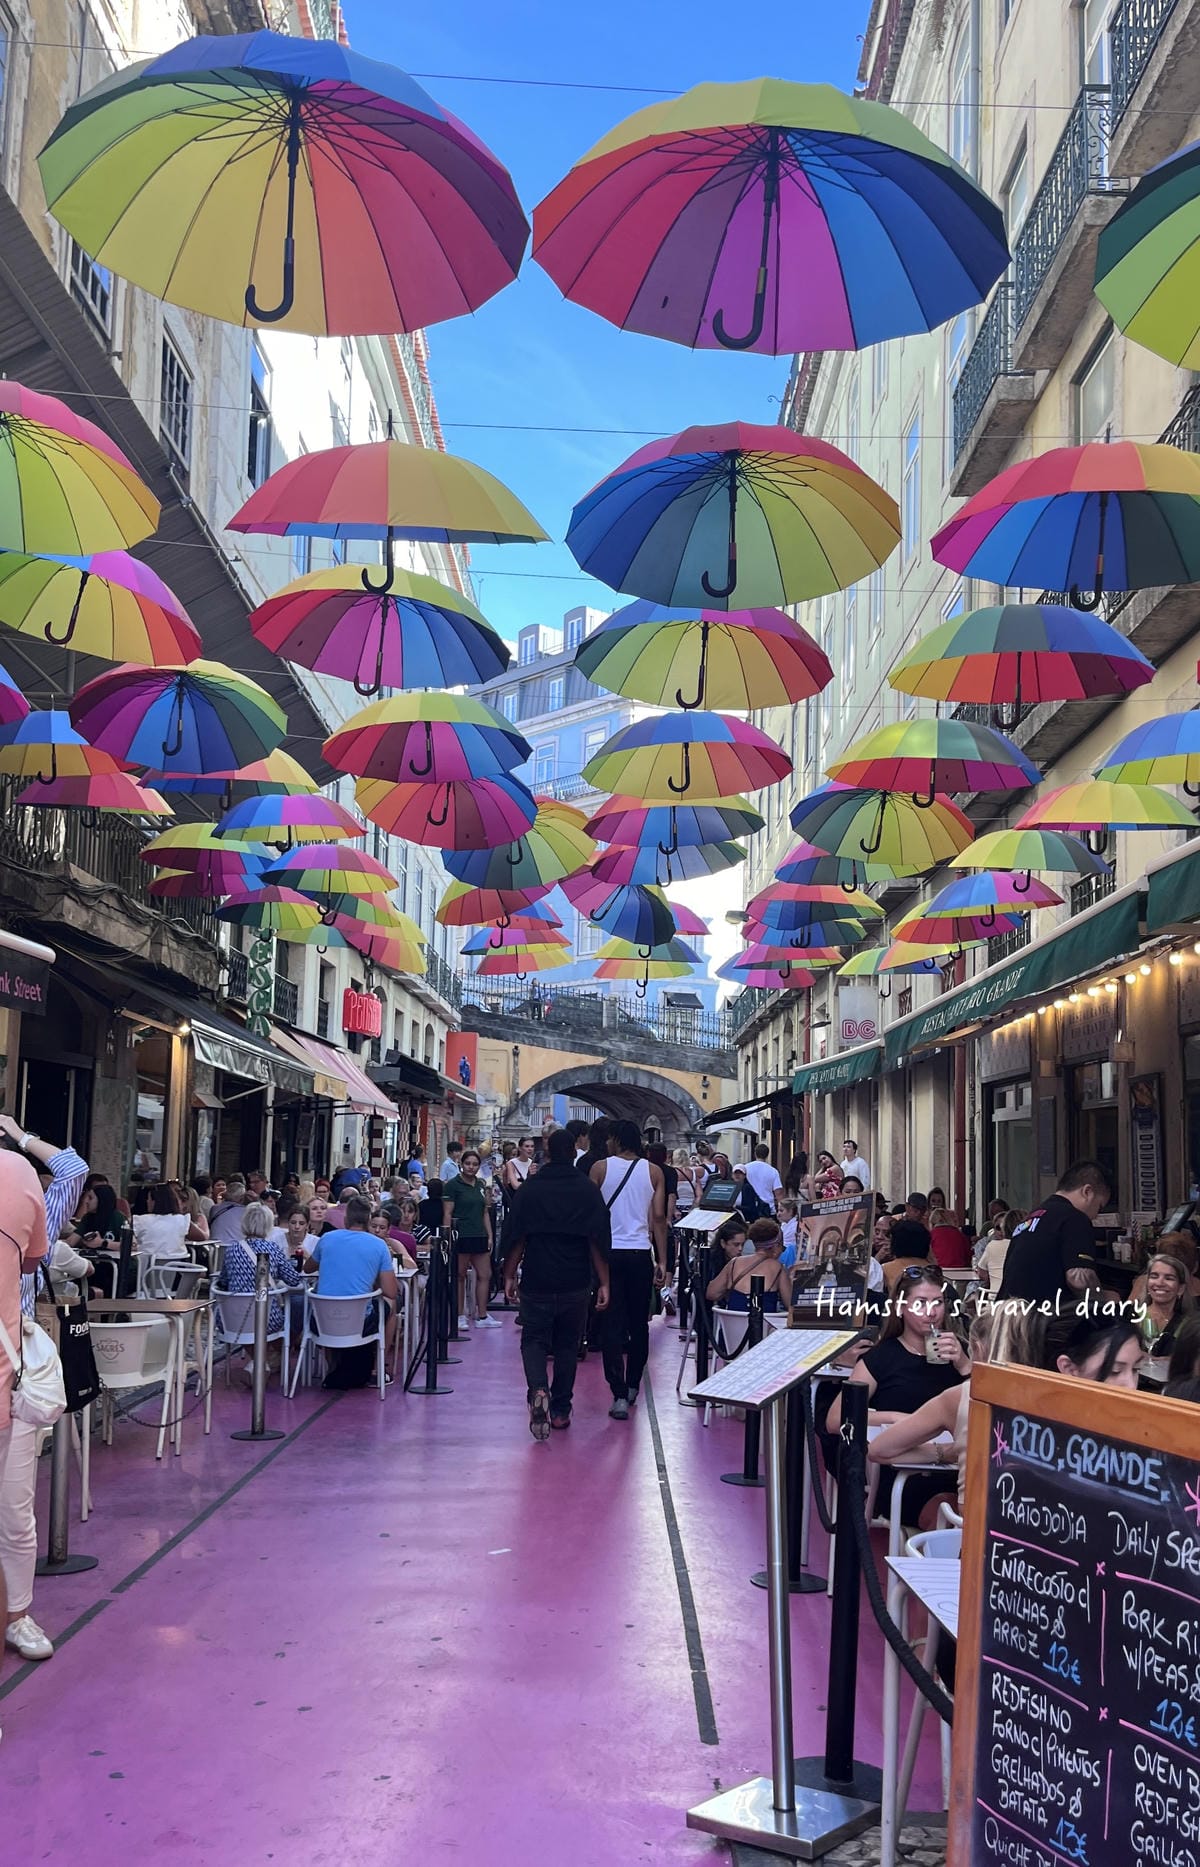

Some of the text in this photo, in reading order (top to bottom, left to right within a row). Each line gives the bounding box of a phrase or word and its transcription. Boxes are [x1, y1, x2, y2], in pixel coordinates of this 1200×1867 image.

[13, 975, 43, 1002] Street
[986, 966, 1025, 1004] GRANDE
[1011, 1415, 1163, 1492] RIO GRANDE
[1122, 1590, 1172, 1645] PORK
[993, 1617, 1082, 1686] ARROZ 12€
[992, 1709, 1030, 1750] FORNO
[1049, 1703, 1072, 1734] NO
[1149, 1698, 1198, 1748] 12€
[991, 1743, 1066, 1807] GRELHADOS
[1134, 1744, 1183, 1790] OVEN
[997, 1778, 1091, 1867] BATATA 13€
